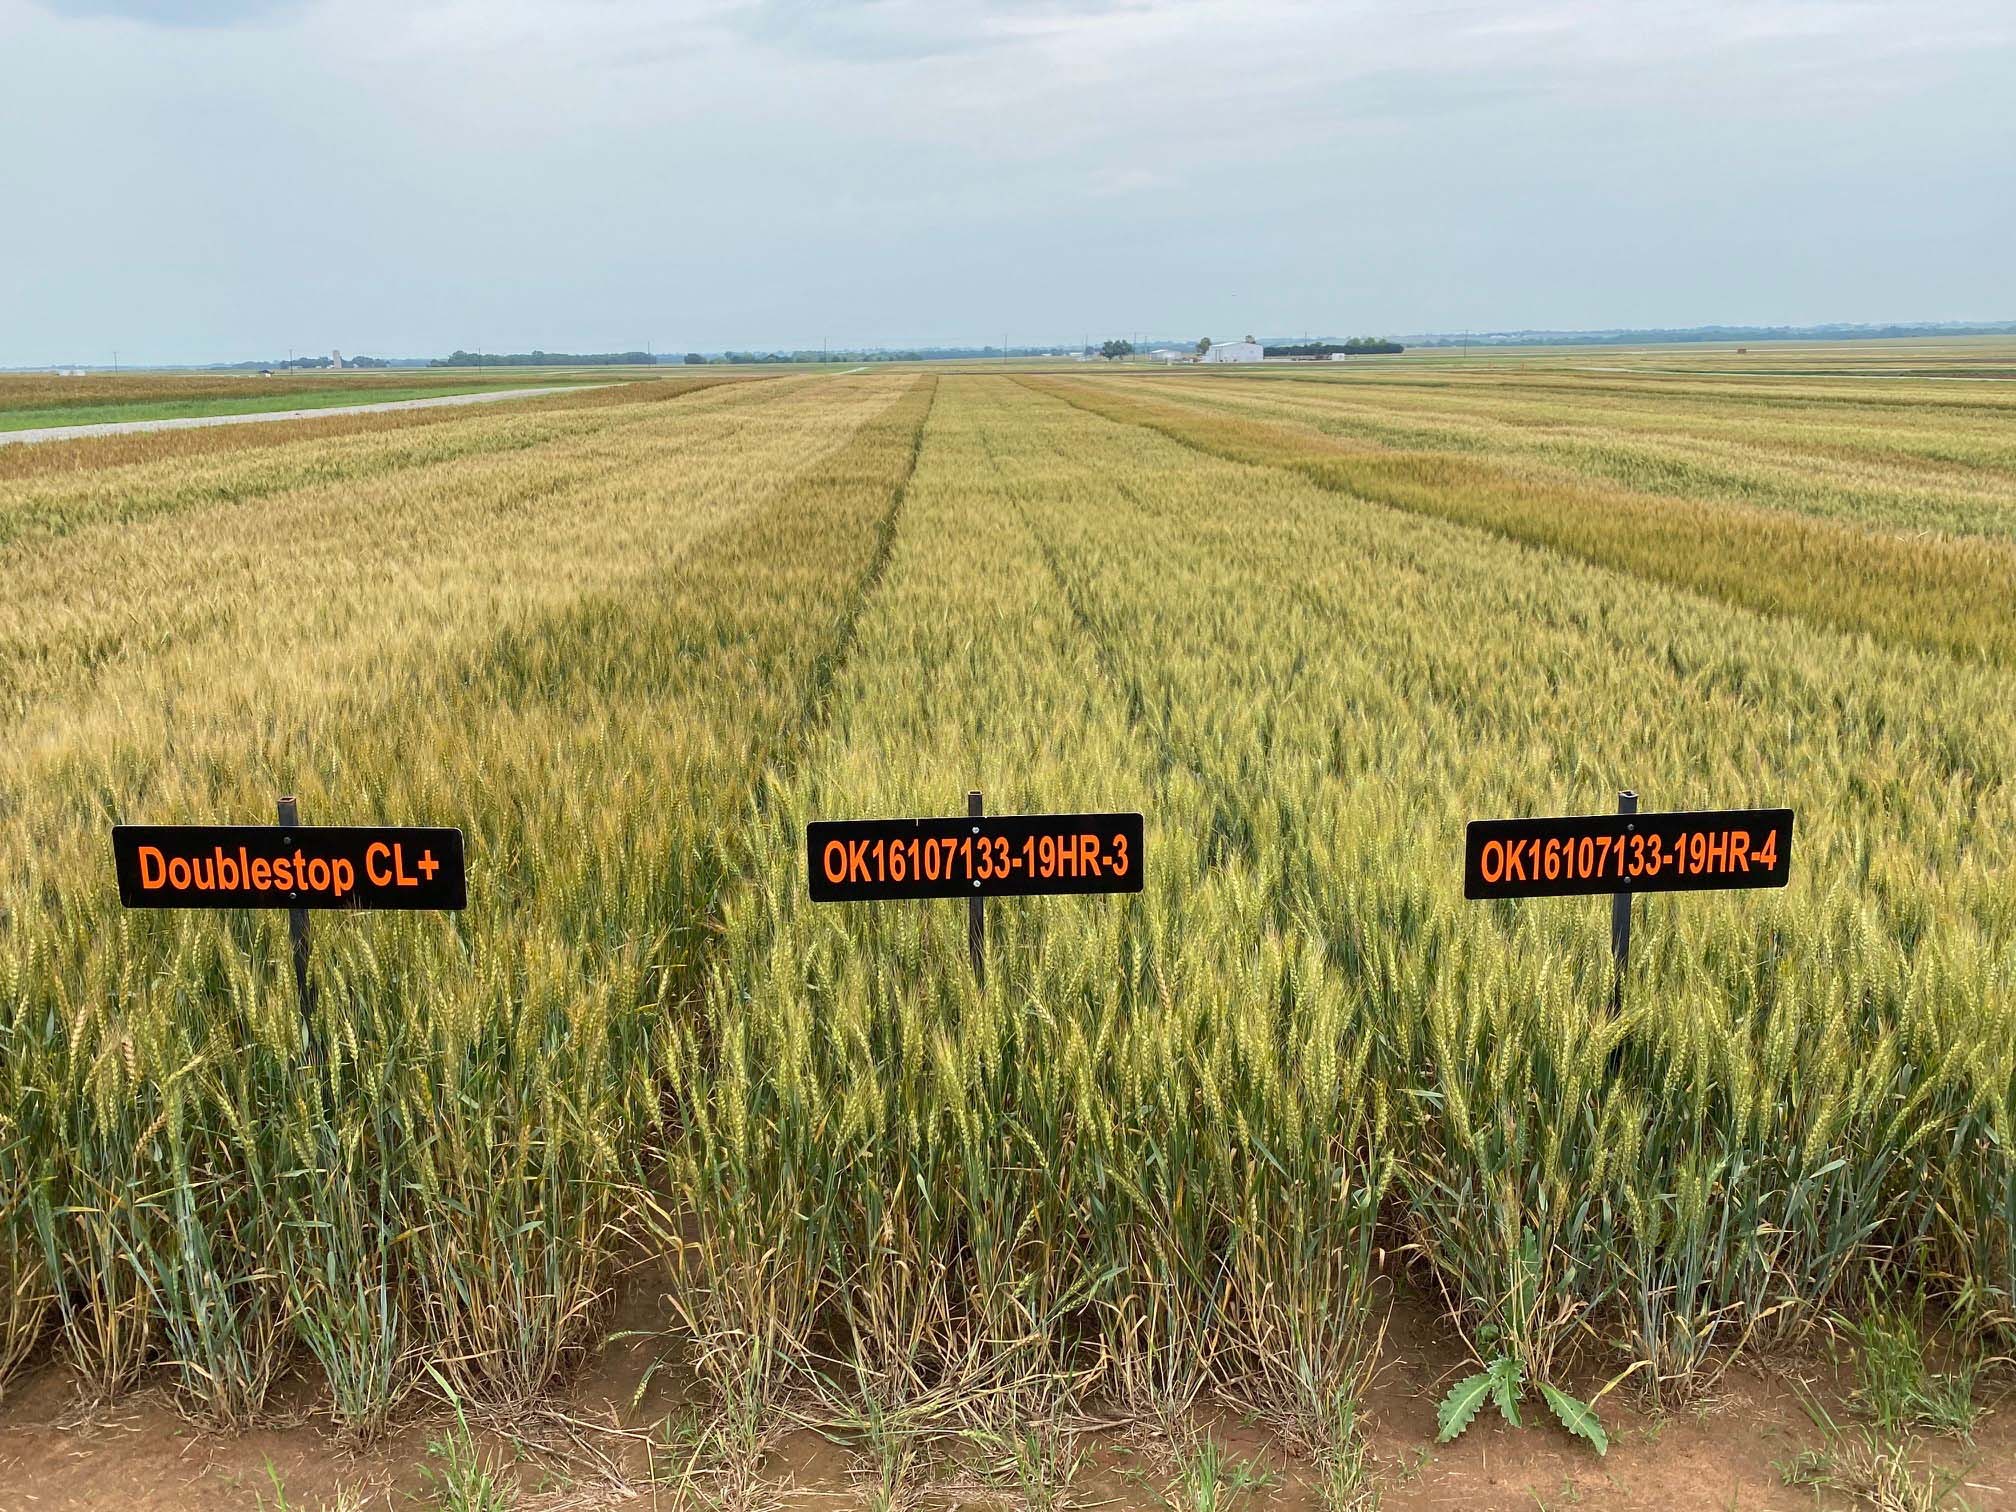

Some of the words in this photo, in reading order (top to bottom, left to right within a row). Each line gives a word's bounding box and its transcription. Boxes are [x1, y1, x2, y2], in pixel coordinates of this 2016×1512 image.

[138, 846, 355, 897] Doublestop
[365, 841, 440, 887] CL+
[823, 833, 1129, 883] OK16107133-19HR-3
[1480, 829, 1777, 883] OK16107133-19HR-4
